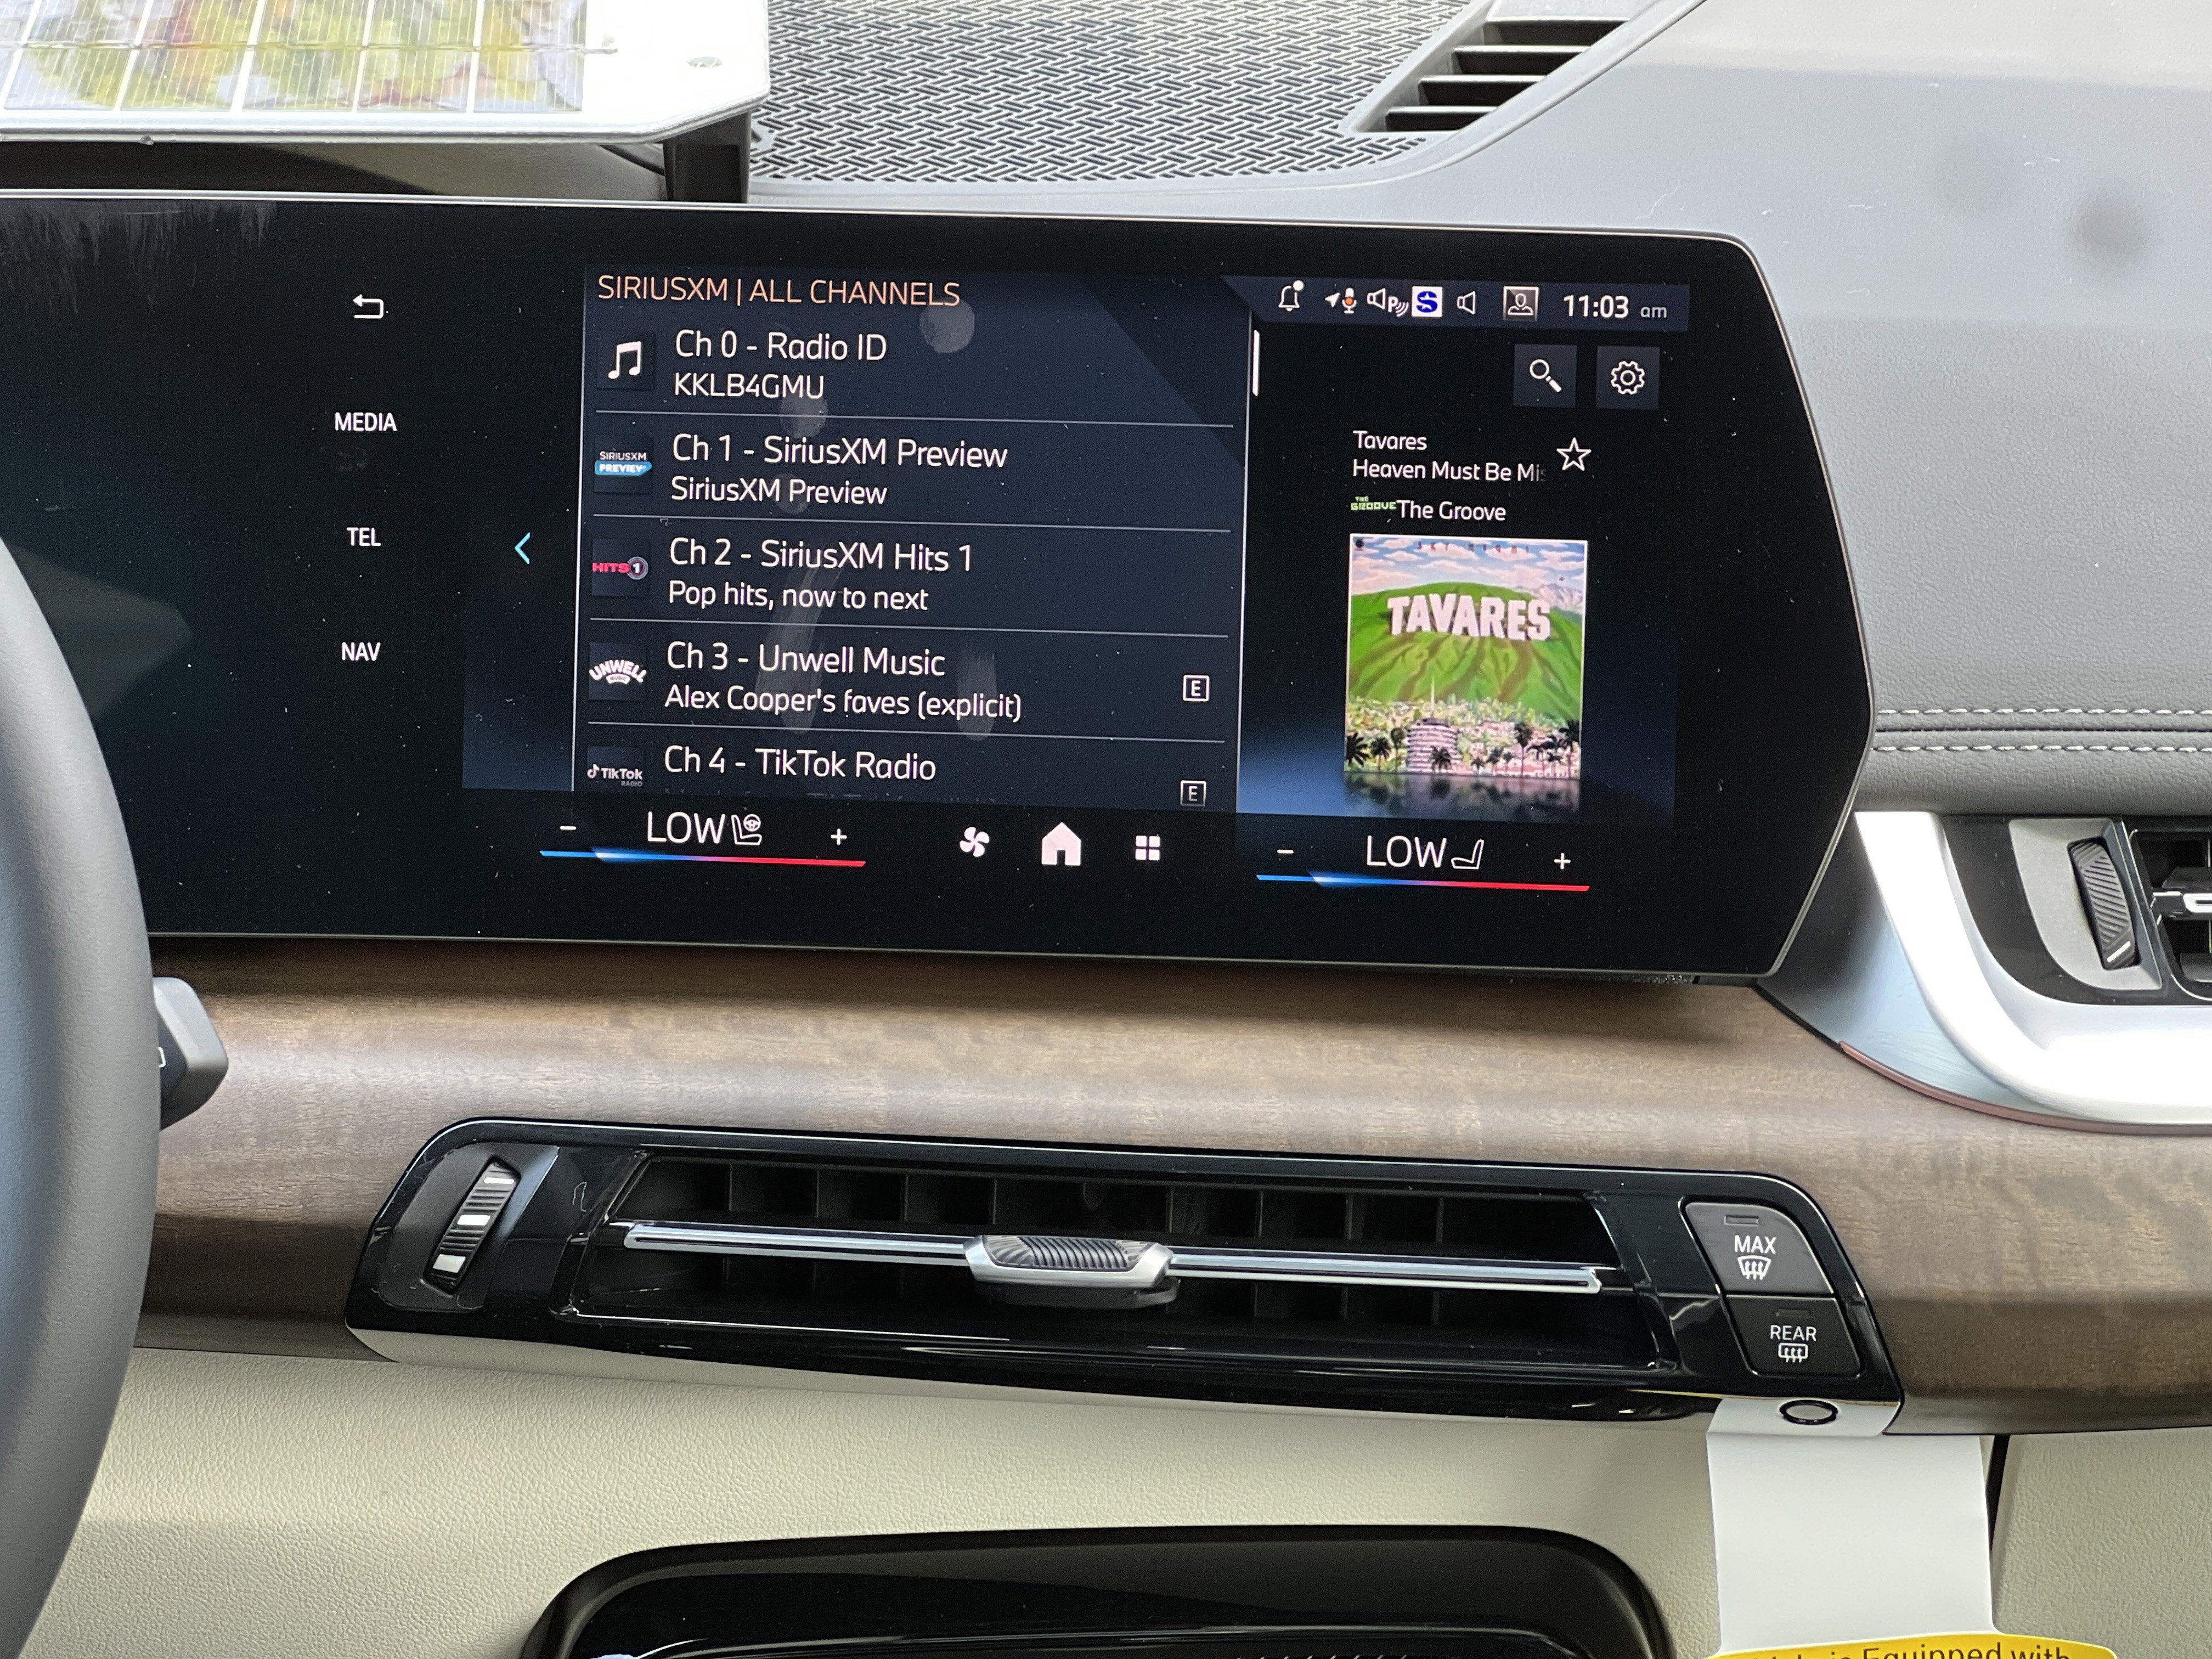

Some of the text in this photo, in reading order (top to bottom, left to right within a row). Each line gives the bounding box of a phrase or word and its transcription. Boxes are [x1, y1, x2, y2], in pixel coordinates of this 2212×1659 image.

[598, 275, 727, 301] SIRIUSXM
[749, 279, 802, 303] ALL
[810, 279, 960, 307] CHANNELS
[1564, 295, 1667, 318] 11:03 am
[676, 329, 712, 357] Ch
[721, 330, 737, 358] 0
[768, 332, 848, 360] Radio
[858, 334, 887, 360] ID
[675, 372, 824, 399] KKLB4GMU
[335, 412, 397, 432] MEDIA
[673, 433, 709, 461] Ch
[719, 435, 730, 461] 1
[764, 435, 886, 465] SiriusXM
[898, 439, 1008, 467] Preview
[1352, 430, 1427, 450] Tavares
[599, 451, 647, 461] SIRIUSXM
[1353, 459, 1426, 479] Heaven
[1432, 461, 1480, 481] Must
[1485, 462, 1512, 482] Be
[671, 476, 888, 504] SiriusXM Preview
[1350, 501, 1397, 511] GROOVE
[1396, 499, 1506, 521] The Groove
[346, 527, 381, 546] TEL
[670, 537, 706, 565] Ch
[714, 538, 731, 565] 2
[761, 539, 883, 569] SiriusXM
[895, 543, 949, 572] Hits
[959, 544, 970, 572] 1
[592, 562, 640, 573] HITS 1
[669, 580, 929, 611] Pop hits, now to next
[1387, 593, 1551, 641] TAVARES
[341, 642, 381, 661] NAV
[667, 641, 703, 669] Ch
[712, 642, 728, 670] 3
[759, 644, 854, 673] Unwell
[864, 647, 945, 676] Music
[589, 659, 647, 683] UNWELL
[664, 684, 1021, 723] Alex Cooper's faves (explicit)
[601, 768, 643, 780] TikTok
[665, 745, 701, 772] Ch
[708, 747, 725, 774] 4
[754, 748, 846, 777] TikTok
[856, 751, 936, 780] Radio
[647, 811, 726, 844] LOW
[1367, 835, 1447, 868] LOW
[1734, 1234, 1776, 1254] MAX
[1770, 1324, 1817, 1342] REAR
